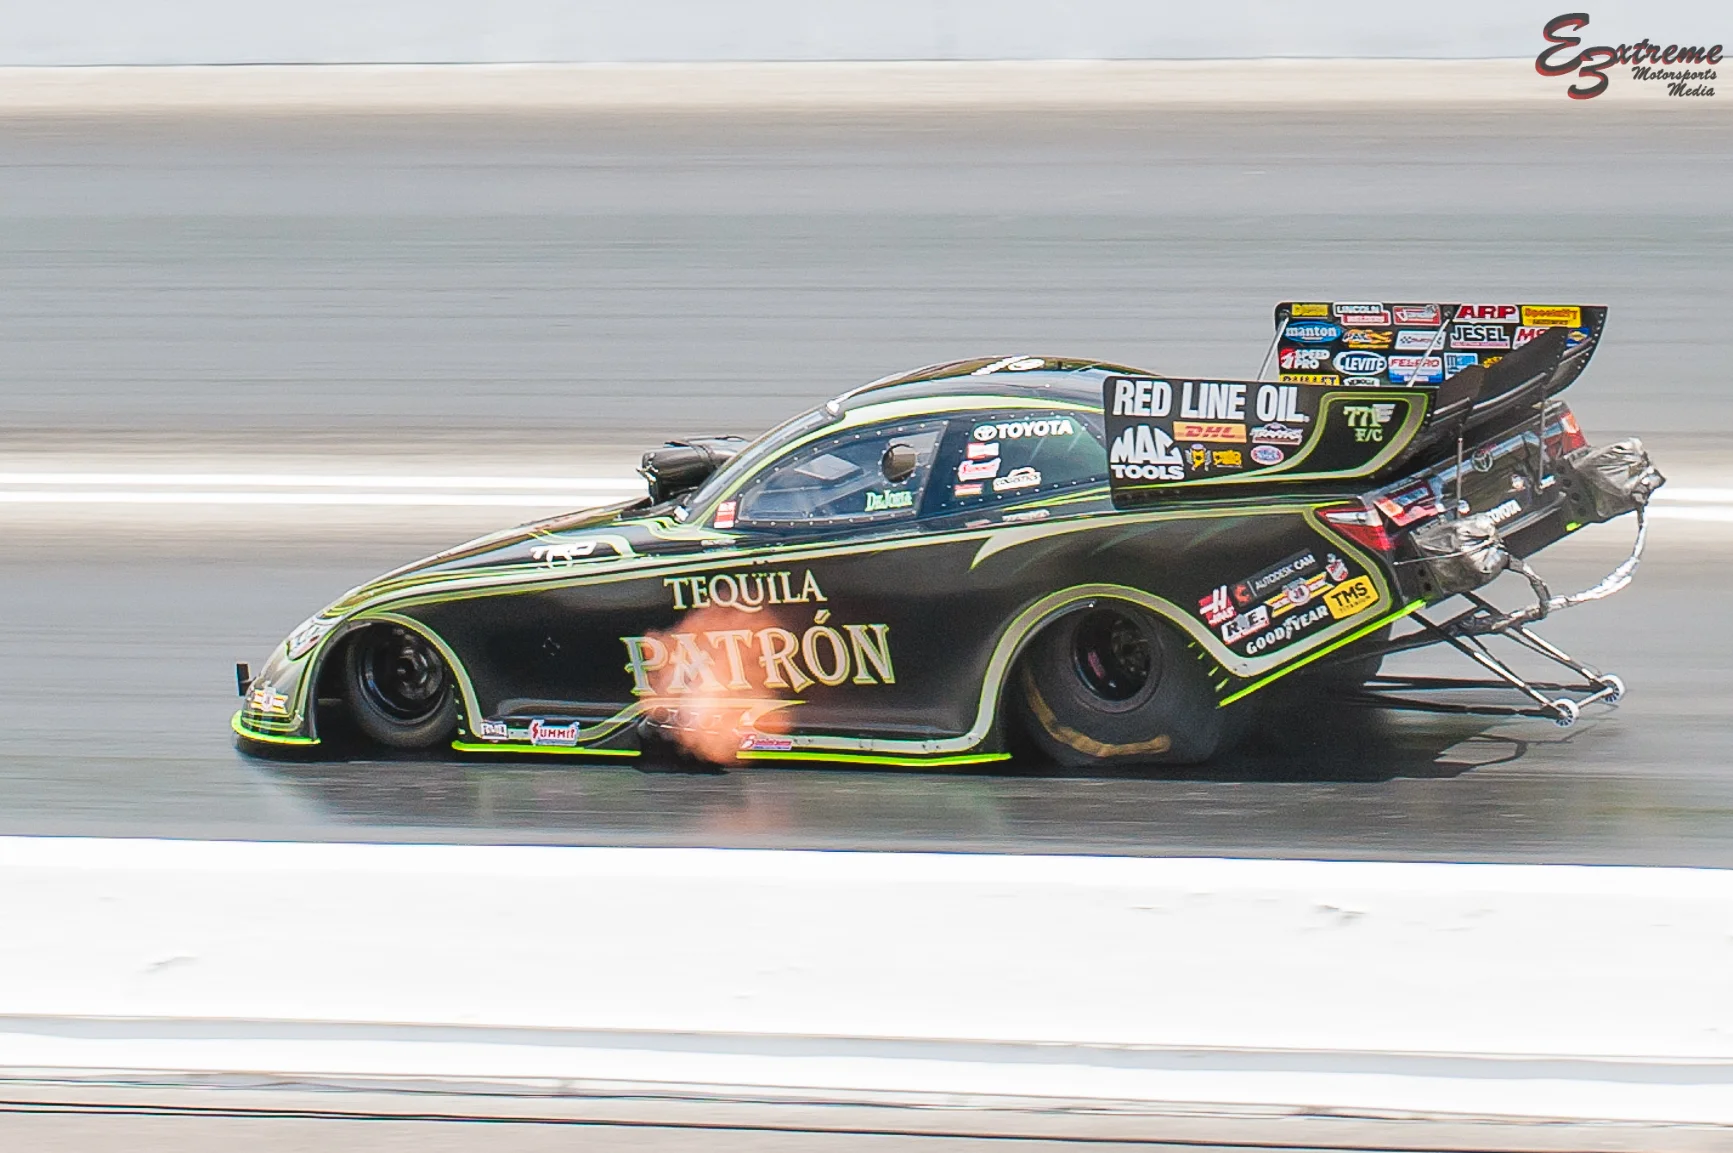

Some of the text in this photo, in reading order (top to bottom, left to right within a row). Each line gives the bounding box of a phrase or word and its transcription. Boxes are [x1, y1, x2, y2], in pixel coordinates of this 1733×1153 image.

[1456, 306, 1516, 319] ARP
[1286, 326, 1337, 337] manton
[1452, 327, 1507, 342] JESEL
[1113, 379, 1305, 422] RED LINE OIL
[996, 420, 1074, 439] TOYOTA
[1185, 425, 1235, 438] DHL
[1110, 424, 1184, 466] MAC
[1110, 465, 1185, 480] TOOLS
[1255, 554, 1316, 591] AUTODESK CAM
[1331, 582, 1367, 606] TMS
[1246, 605, 1330, 655] GOODYEAR
[619, 609, 896, 697] PATRÓN
